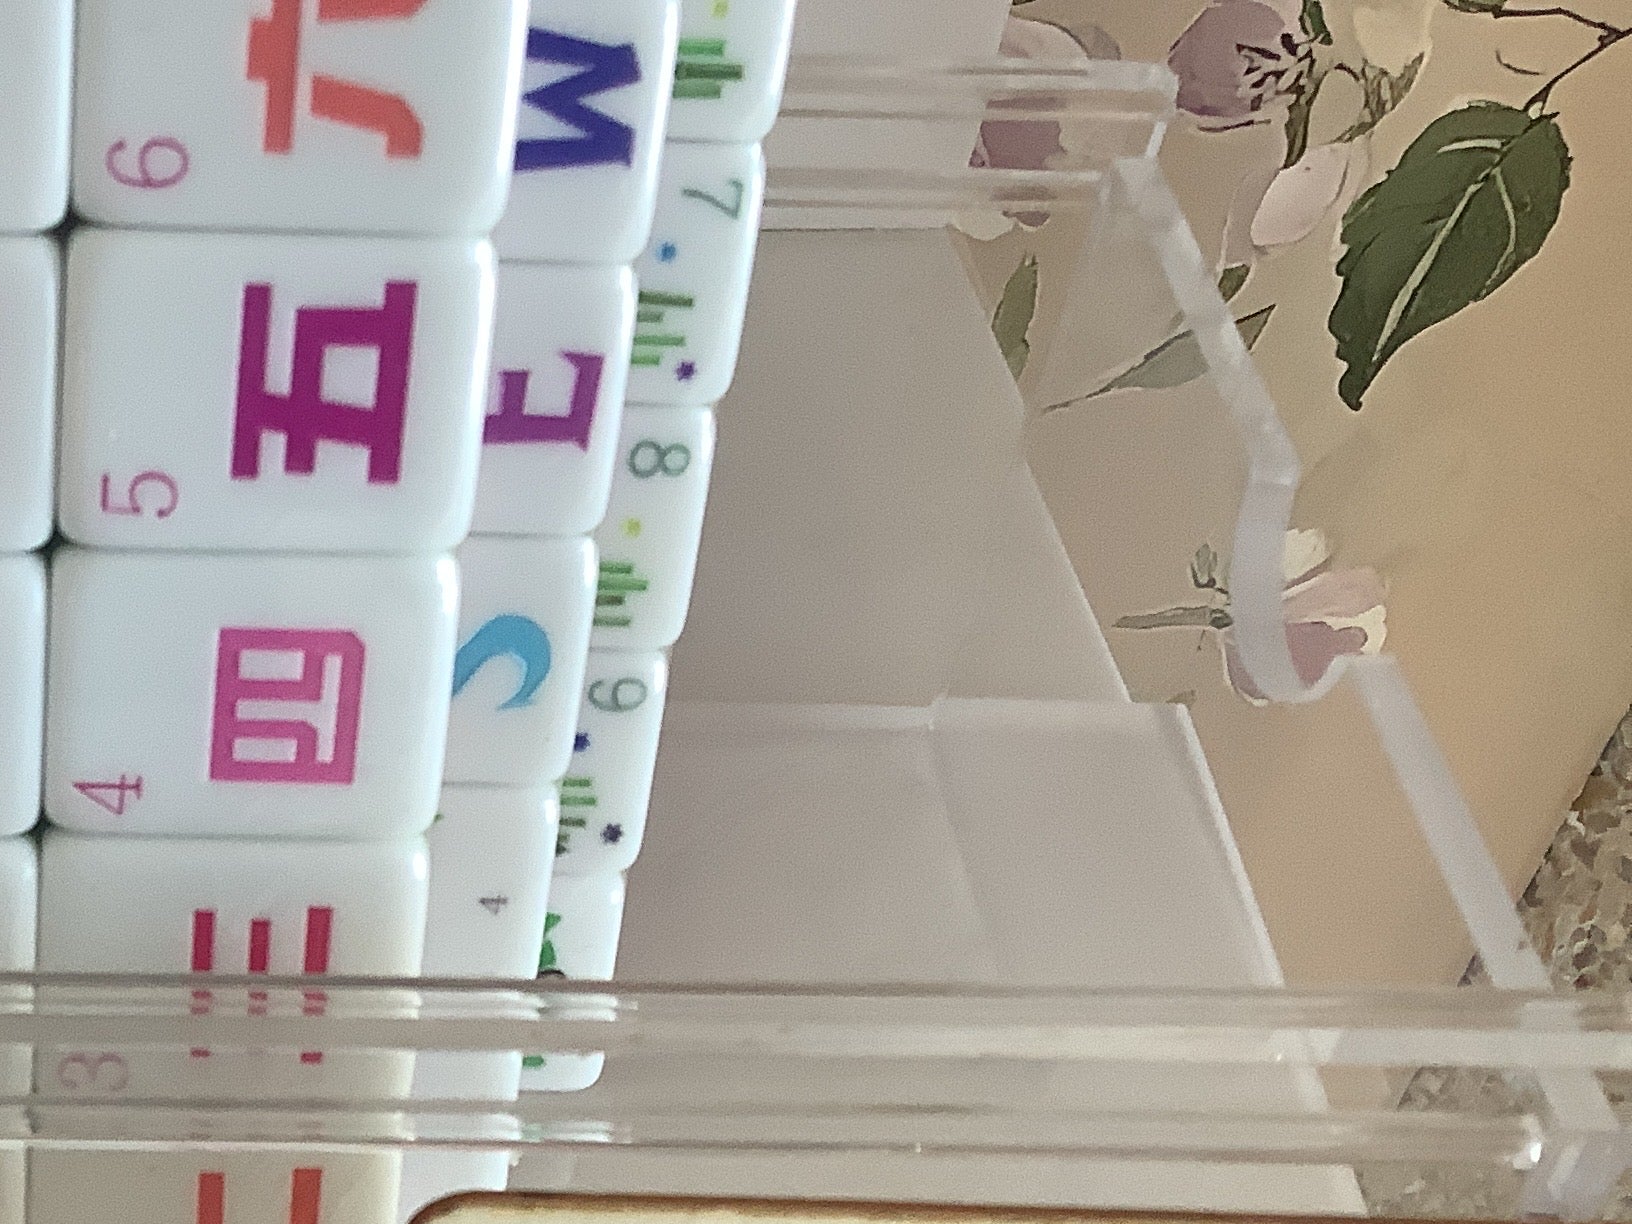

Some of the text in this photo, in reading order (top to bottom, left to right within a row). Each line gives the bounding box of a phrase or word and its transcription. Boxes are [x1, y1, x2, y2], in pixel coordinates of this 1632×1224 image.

[107, 137, 189, 190] 6
[681, 178, 744, 221] 7
[231, 280, 418, 485] 五
[627, 439, 691, 479] 8
[100, 470, 179, 519] 5
[209, 627, 366, 785] 四
[587, 677, 648, 713] 9
[73, 773, 143, 815] 4
[57, 1051, 130, 1093] 3
